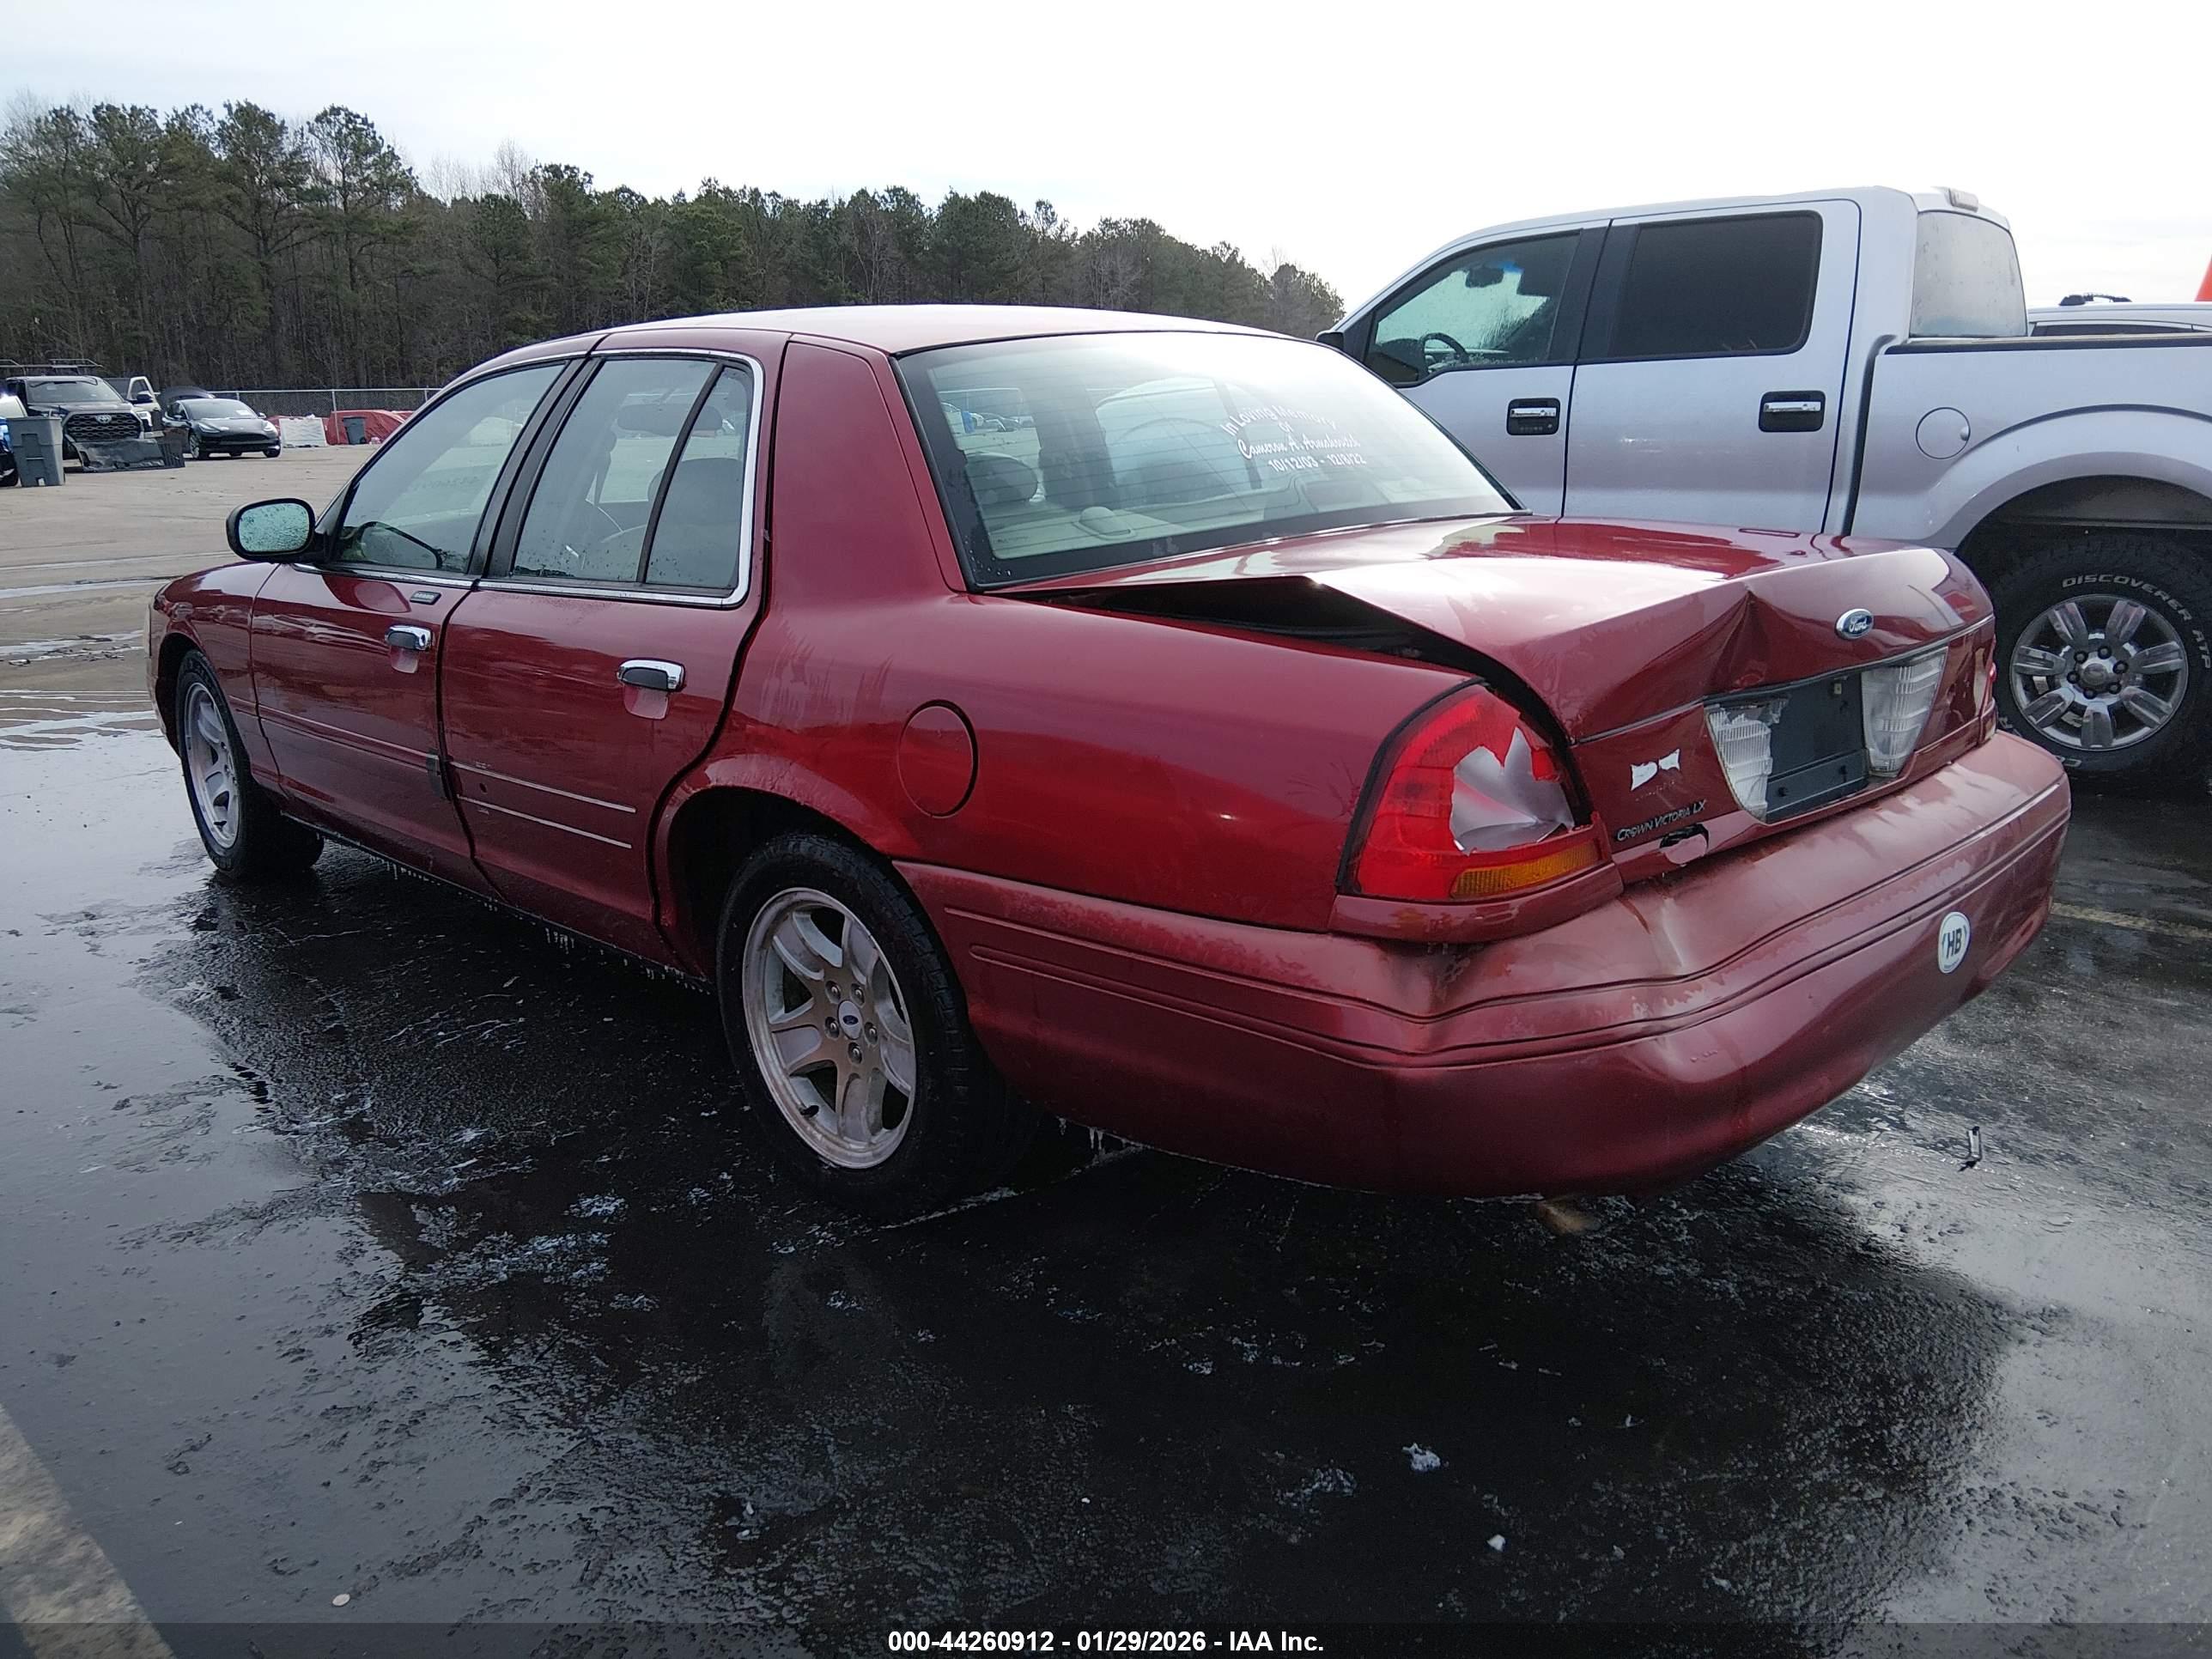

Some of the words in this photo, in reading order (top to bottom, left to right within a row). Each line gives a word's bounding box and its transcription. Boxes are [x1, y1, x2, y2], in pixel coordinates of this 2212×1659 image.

[1219, 423, 1239, 437] In
[1229, 407, 1279, 428] Loving
[1272, 404, 1337, 430] Memory
[1237, 439, 1288, 459] Cameron
[1267, 456, 1320, 473] 10/12/03
[2062, 574, 2193, 621] DISCOVERER
[1616, 819, 1655, 842] CROWN
[1655, 807, 1691, 828] VICTORIA
[1692, 799, 1708, 814] LX
